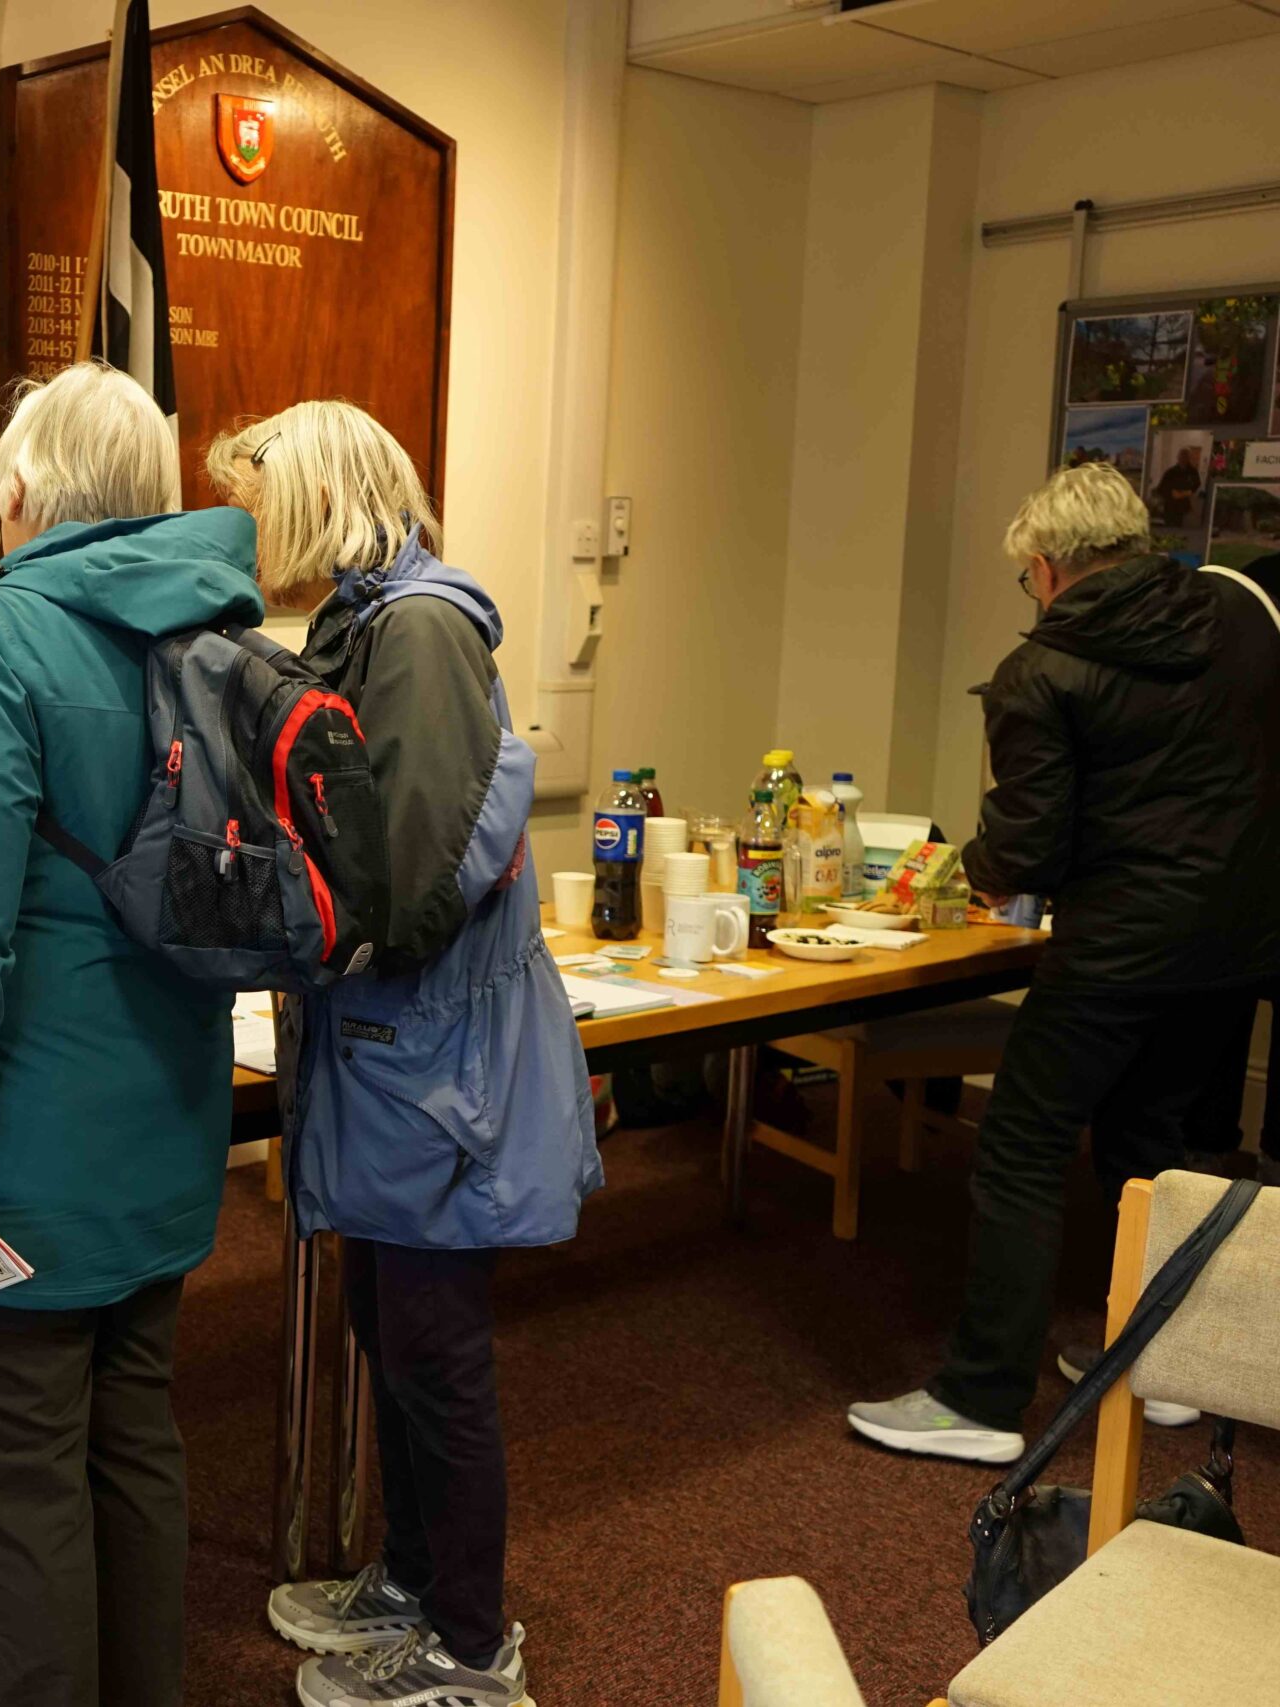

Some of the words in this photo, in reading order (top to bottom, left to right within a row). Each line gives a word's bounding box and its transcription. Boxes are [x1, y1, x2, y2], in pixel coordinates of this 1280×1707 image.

[152, 64, 195, 115] NSEL
[199, 54, 225, 78] AN
[230, 54, 277, 84] DREA
[158, 190, 211, 222] RUTH
[215, 197, 276, 229] TOWN
[279, 205, 363, 241] COUNCIL
[177, 233, 235, 260] TOWN
[236, 240, 302, 268] MAYOR
[27, 253, 70, 273] 2010-11
[27, 275, 71, 295] 2011-12
[27, 296, 71, 315] 2012-13
[169, 306, 193, 324] SON
[27, 317, 72, 336] 2013-14
[170, 328, 193, 346] SON
[195, 330, 219, 348] MBE
[816, 846, 841, 860] alpro
[393, 1689, 445, 1707] MERRELL
